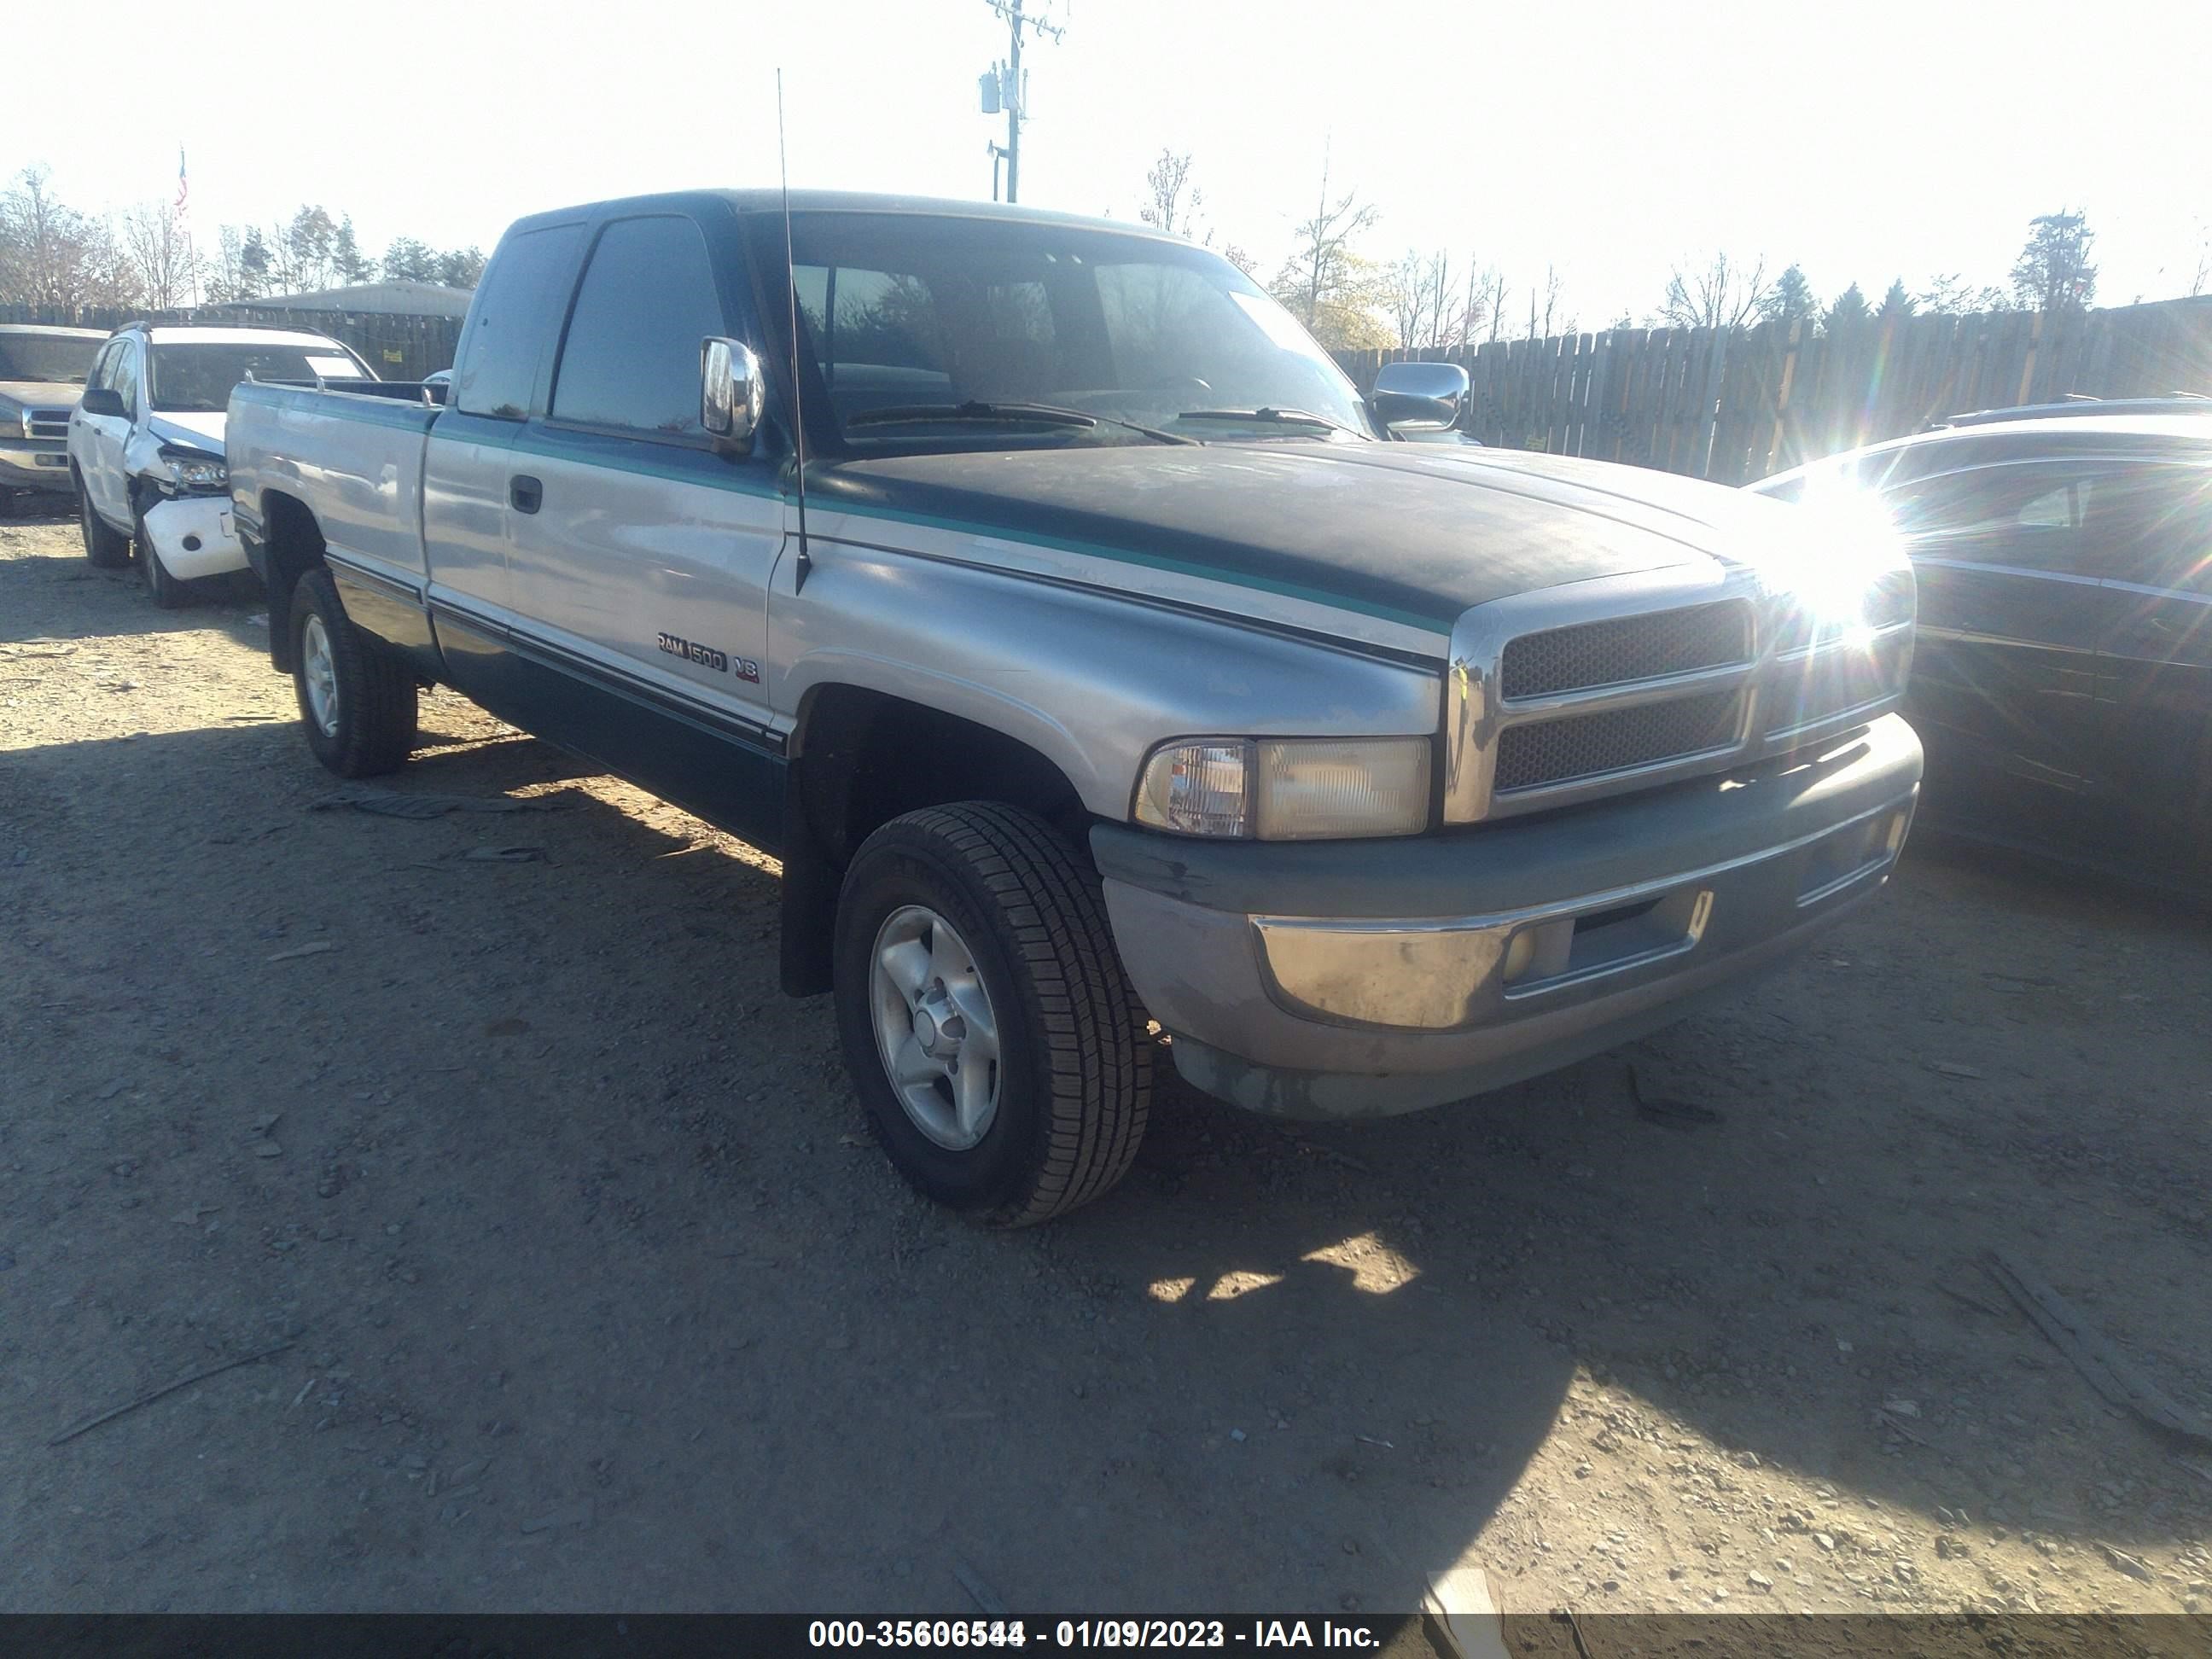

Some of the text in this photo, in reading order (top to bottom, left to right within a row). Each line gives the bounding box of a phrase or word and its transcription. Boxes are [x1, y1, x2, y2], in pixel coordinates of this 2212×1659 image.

[657, 632, 687, 659] RAM
[688, 643, 728, 672] 1500
[734, 656, 758, 678] V8
